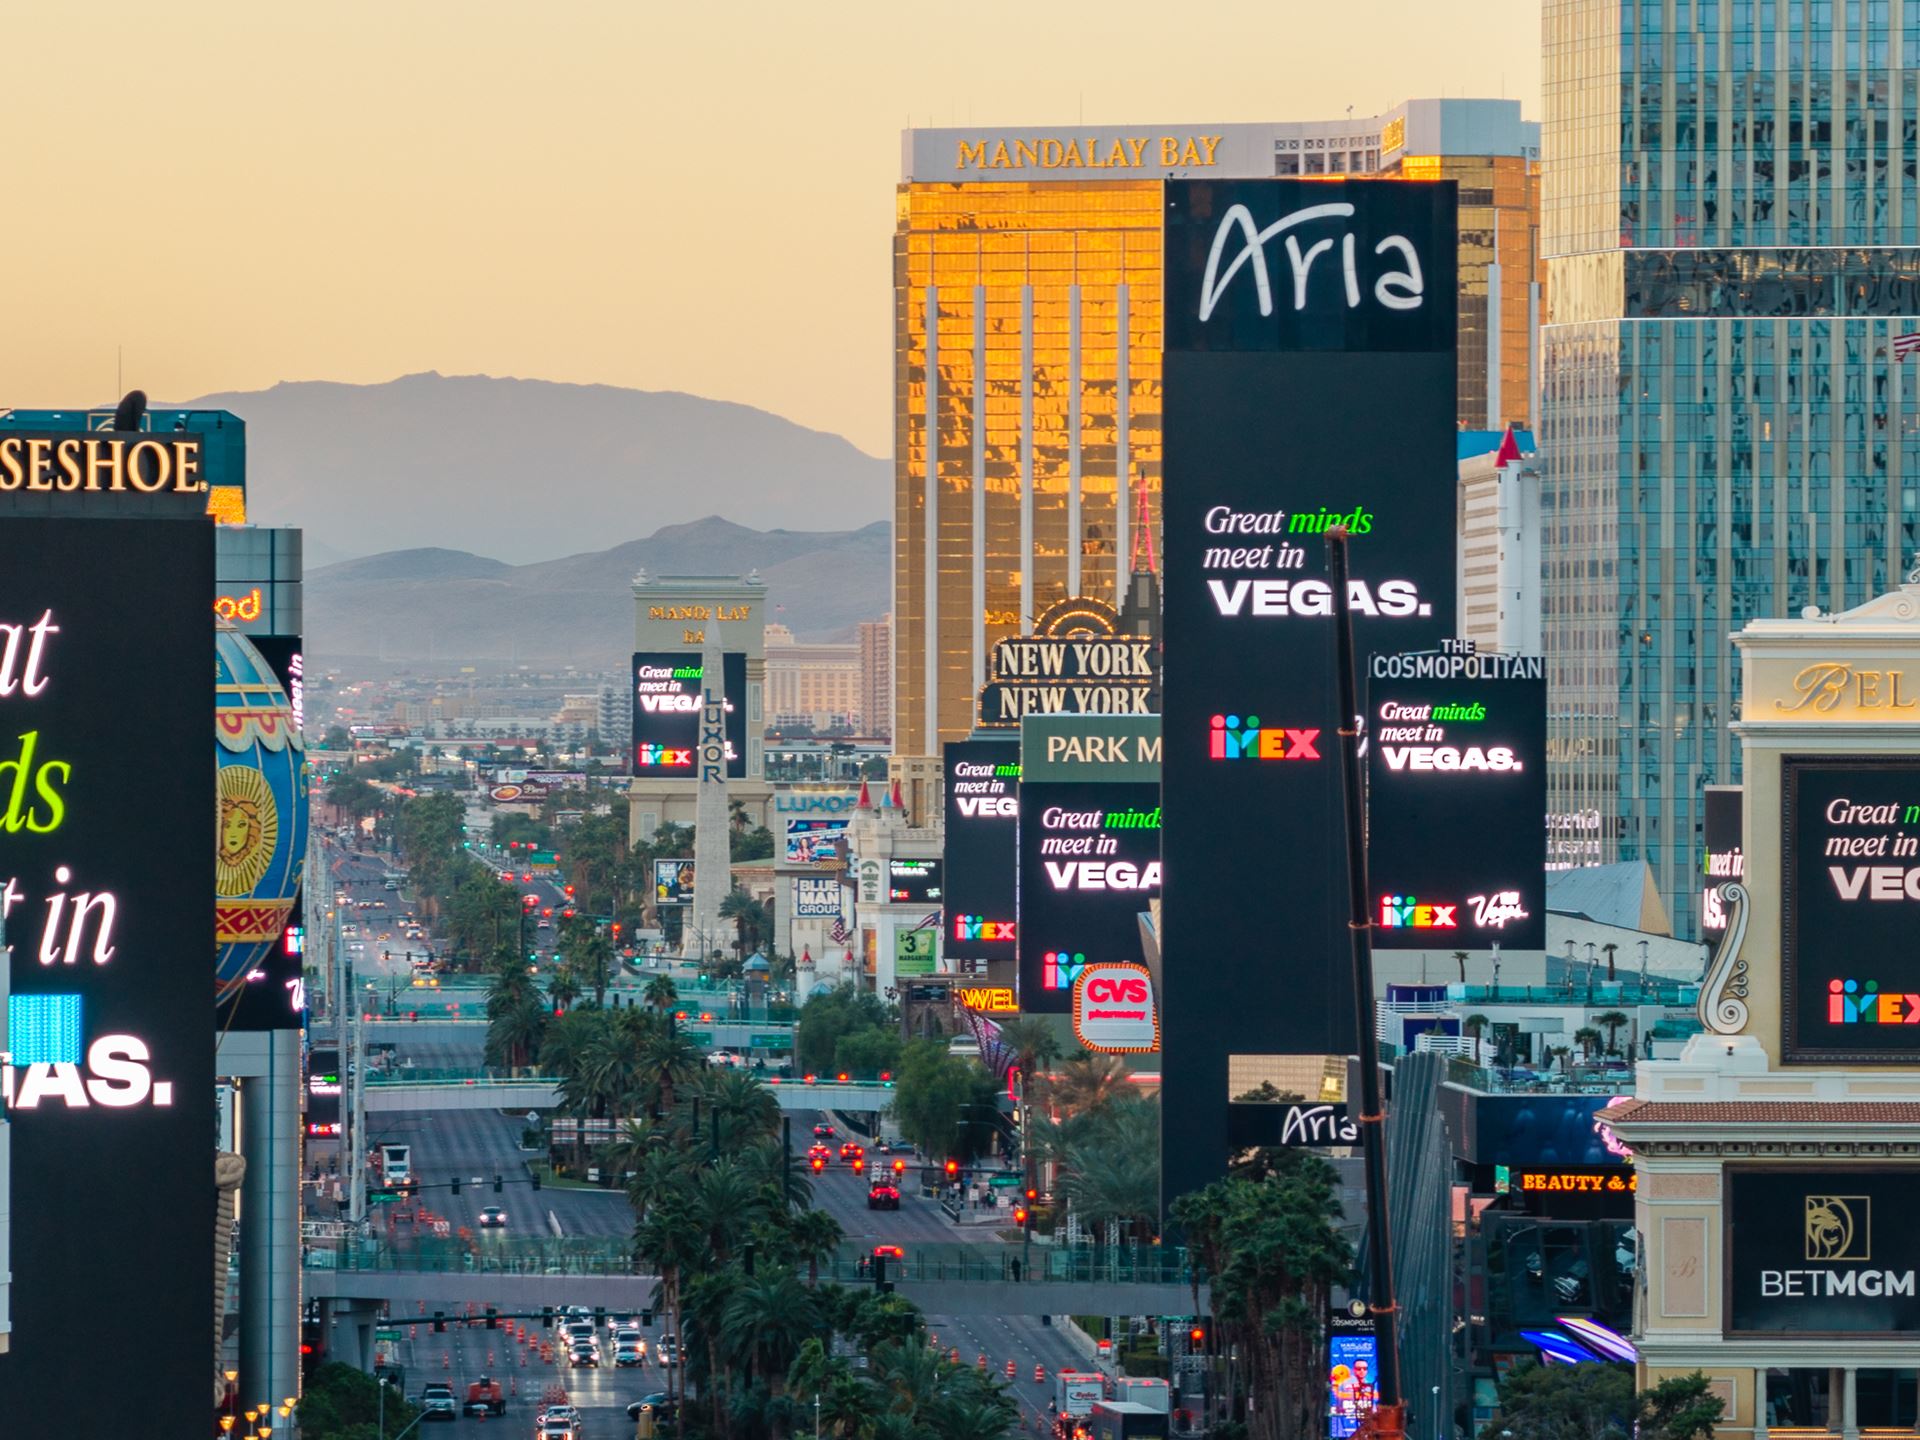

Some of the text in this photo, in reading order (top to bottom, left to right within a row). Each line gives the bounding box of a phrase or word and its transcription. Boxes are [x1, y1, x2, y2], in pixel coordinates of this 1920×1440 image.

[956, 136, 1223, 170] MANDALAY BAY
[1199, 203, 1424, 322] Aria
[0, 438, 200, 491] SESHOE
[1205, 506, 1374, 535] Great minds
[1203, 541, 1305, 569] meet in
[1207, 580, 1432, 616] VEGAS.
[1441, 639, 1476, 654] THE
[639, 665, 673, 679] Great
[1000, 644, 1152, 676] NEW YORK
[1373, 656, 1543, 679] COSMOPOLITAN
[639, 680, 681, 692] meet in
[1000, 687, 1151, 719] NEW YORK
[1380, 702, 1486, 721] Great minds
[702, 688, 725, 784] LUXOR
[1380, 724, 1444, 743] meet in
[1047, 736, 1129, 763] PARK
[1383, 747, 1523, 771] VEGAS.
[955, 762, 994, 776] Great
[954, 779, 1005, 793] meet in
[1042, 807, 1102, 829] Great
[1825, 799, 1900, 824] Great
[1042, 833, 1117, 855] meet in
[1825, 832, 1918, 857] meet in
[800, 880, 839, 891] BLUE
[800, 892, 840, 904] MAN
[39, 867, 116, 966] in
[800, 904, 840, 914] GROUP
[1087, 978, 1148, 1003] CVS
[1281, 1105, 1358, 1144] Aria
[1523, 1174, 1604, 1190] BEAUTY
[1607, 1175, 1626, 1190] &
[1761, 1270, 1915, 1297] BETMGM
